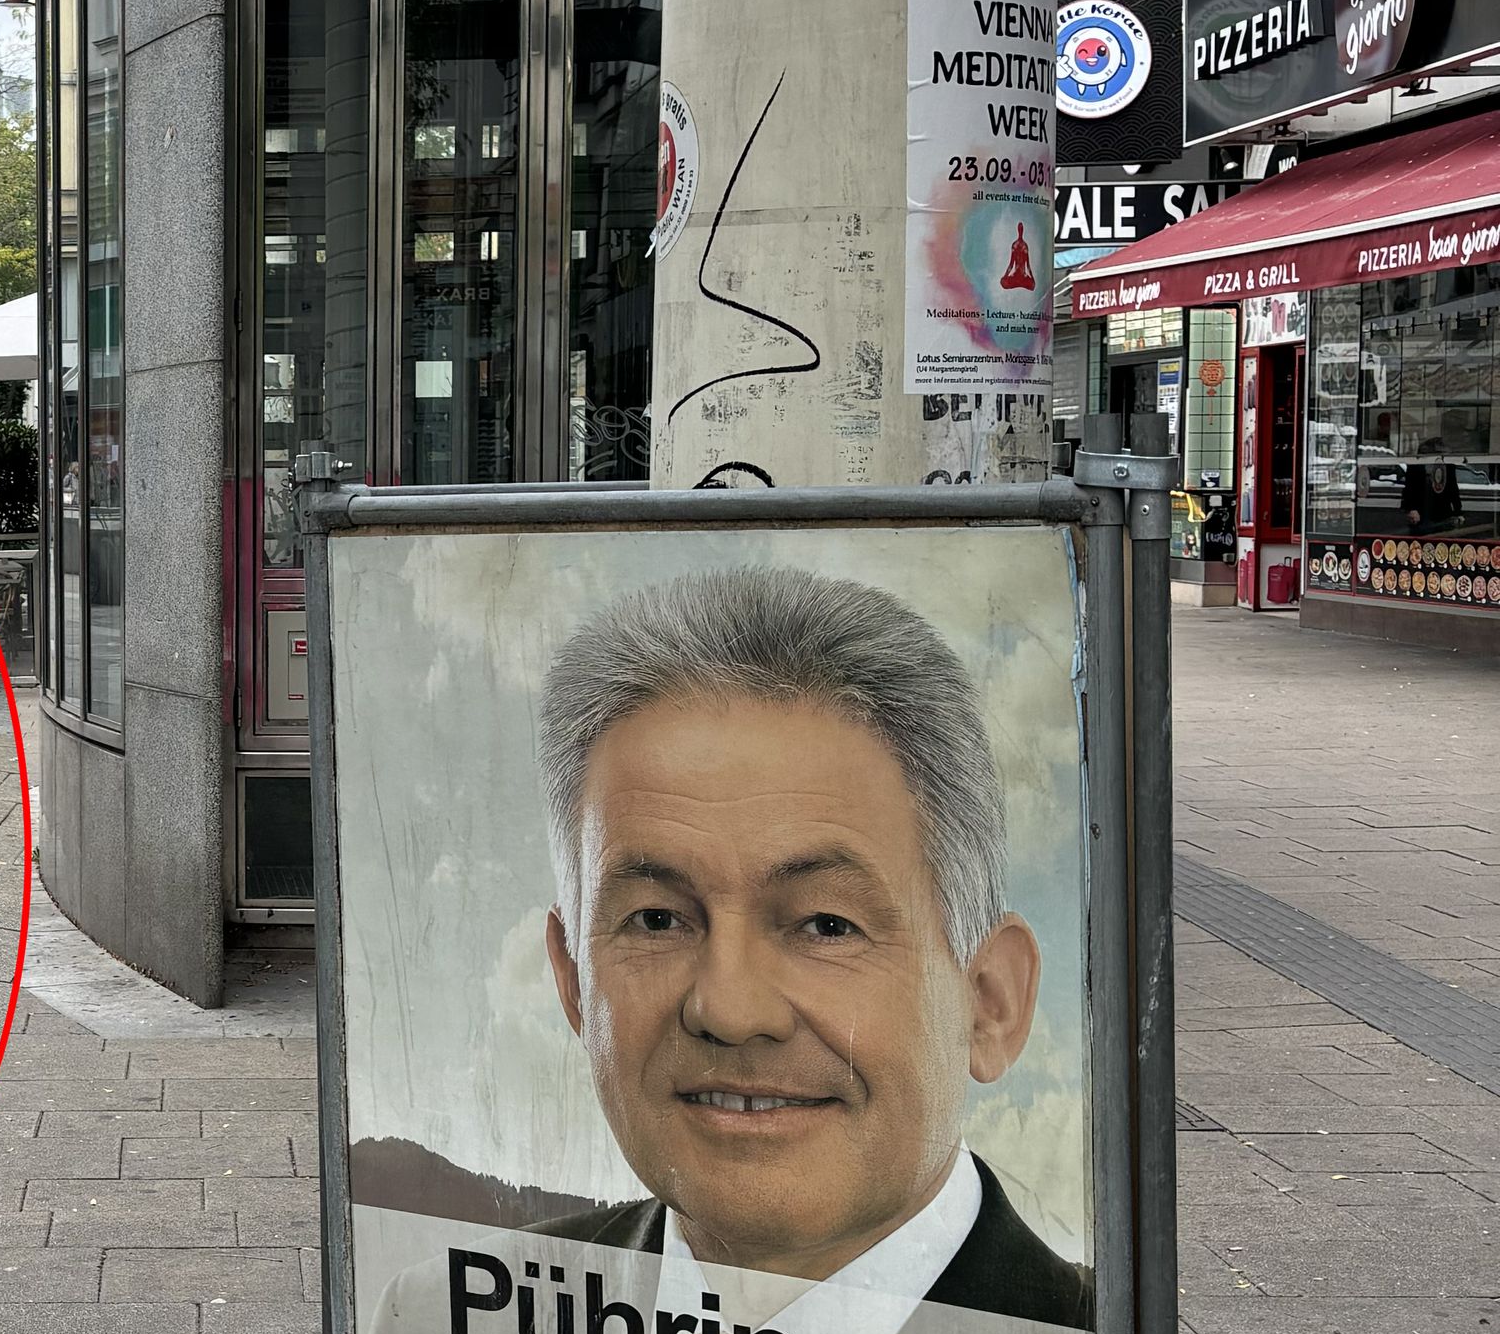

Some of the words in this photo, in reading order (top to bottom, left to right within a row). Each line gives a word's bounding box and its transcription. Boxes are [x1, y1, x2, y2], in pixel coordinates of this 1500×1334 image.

[974, 0, 1054, 44] VIENNA
[932, 51, 1056, 97] MEDITATIO
[987, 103, 1048, 144] WEEK
[672, 158, 685, 208] WLAN
[973, 190, 984, 201] all
[985, 192, 1010, 202] events
[1357, 240, 1422, 273] PIZZERIA
[1203, 271, 1241, 296] PIZZA
[1245, 270, 1256, 291] &
[1258, 262, 1301, 287] GRILL
[925, 308, 981, 320] Meditations
[1078, 288, 1117, 312] PIZZERIA
[995, 323, 1009, 333] and
[916, 353, 941, 364] Lotus
[942, 352, 1004, 365] Seminarzentrum,
[915, 377, 932, 385] more
[933, 375, 972, 385] information
[973, 376, 984, 385] and
